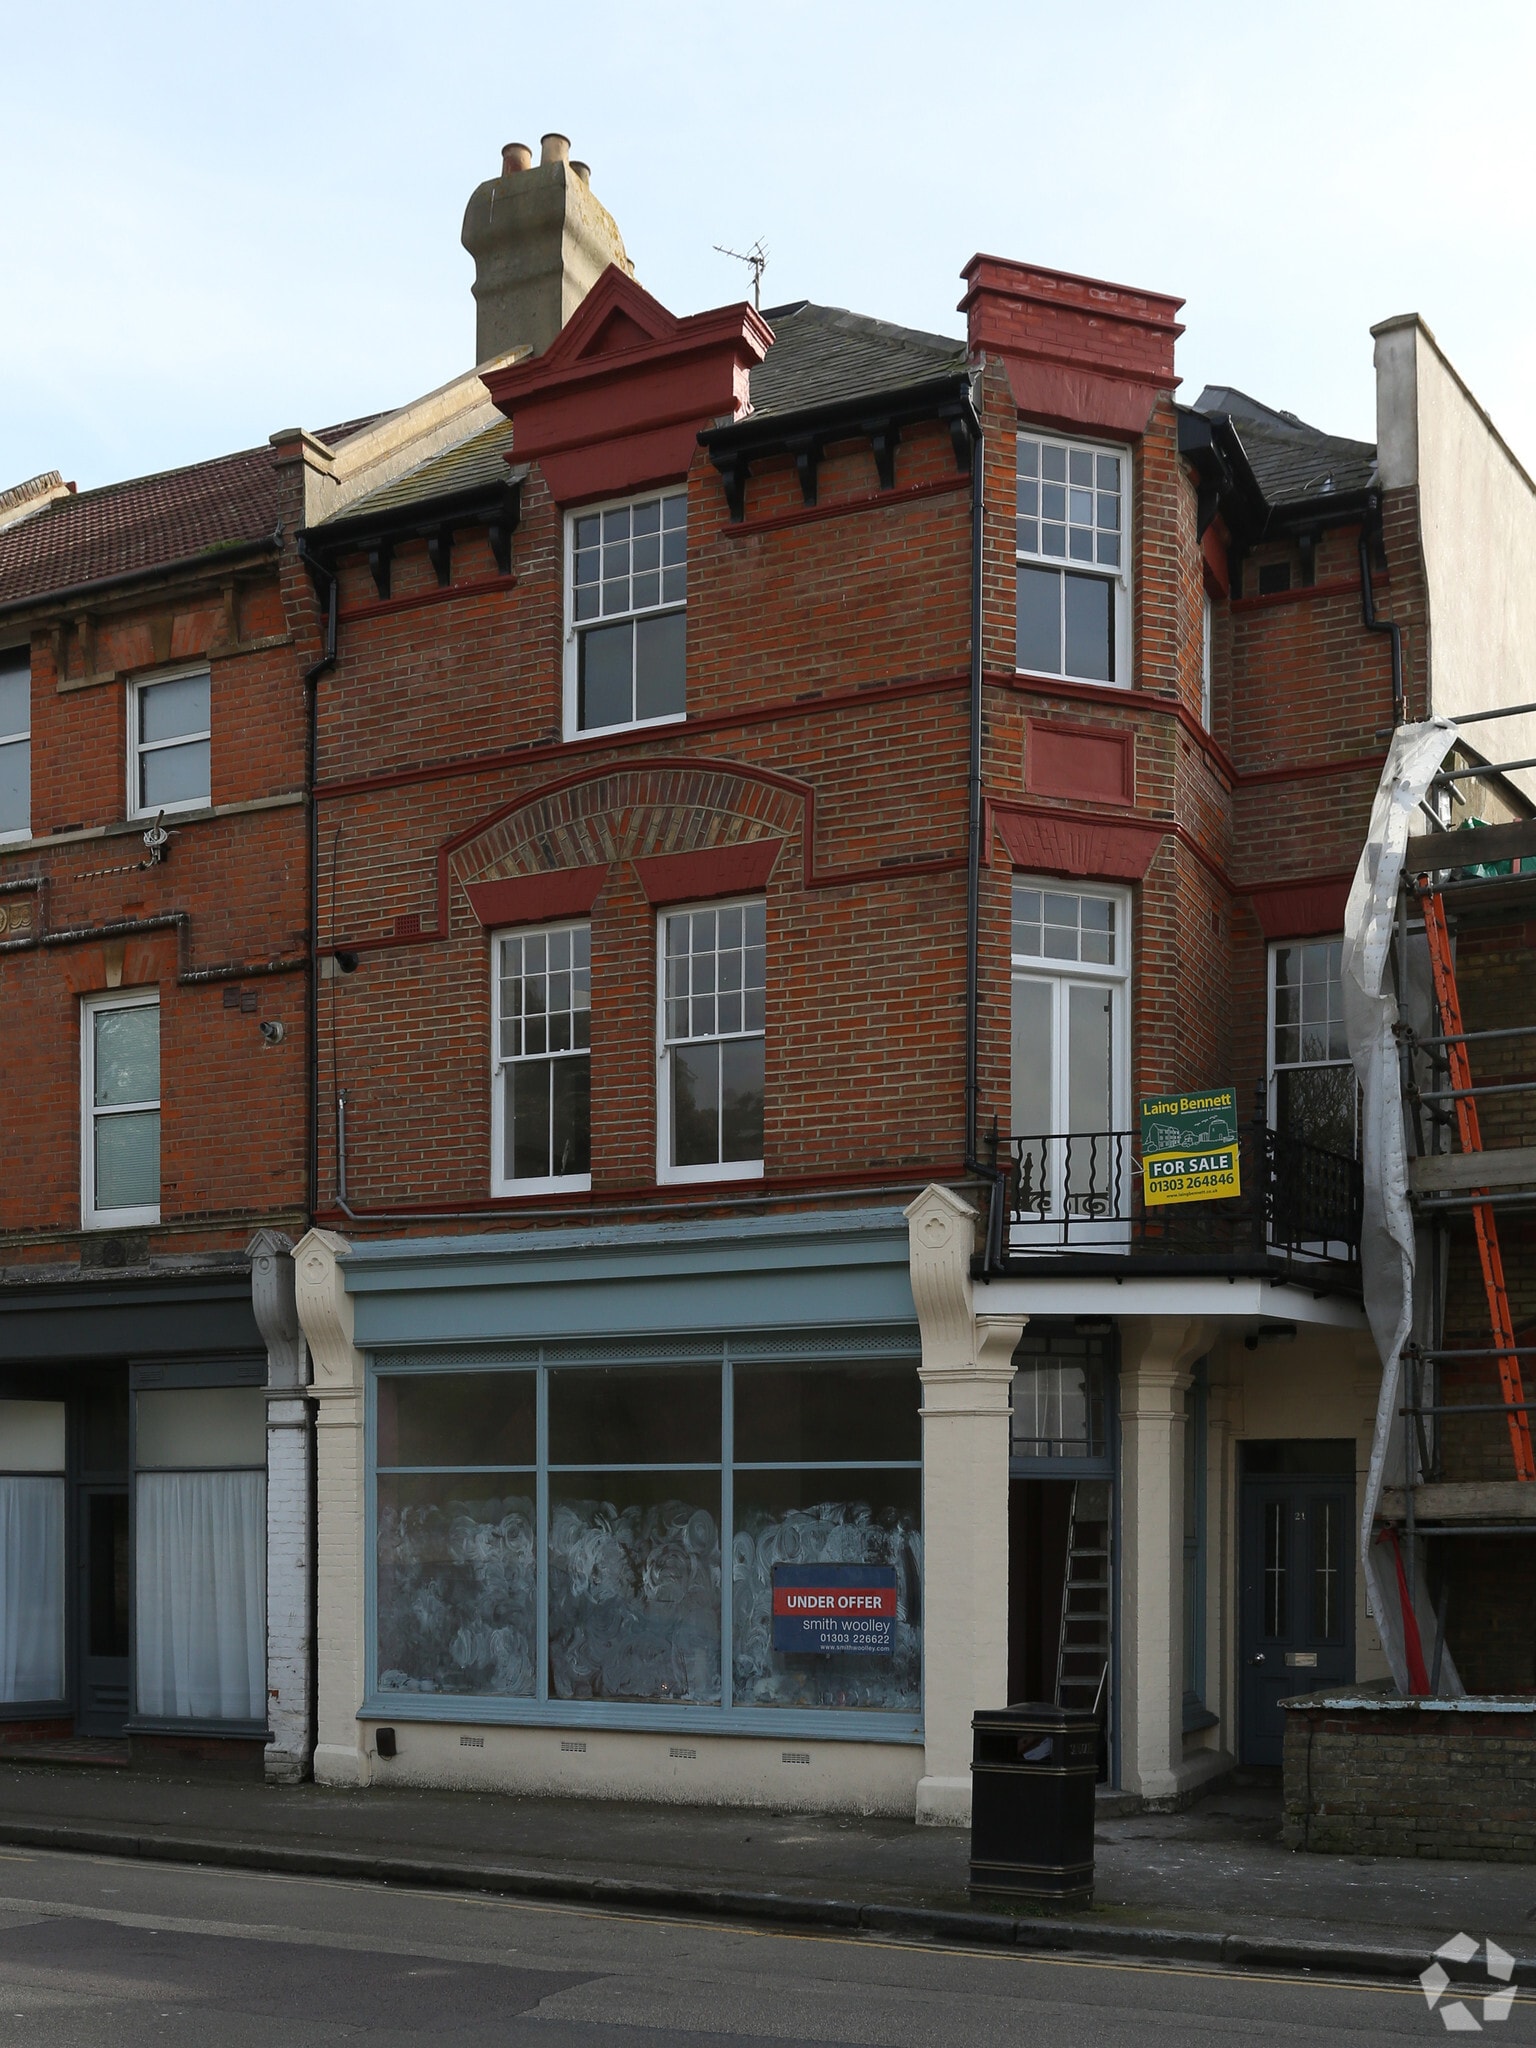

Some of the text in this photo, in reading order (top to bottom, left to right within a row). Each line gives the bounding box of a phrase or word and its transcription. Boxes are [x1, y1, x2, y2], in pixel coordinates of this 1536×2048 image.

[1143, 1101, 1178, 1116] Laing
[1180, 1093, 1232, 1111] Bennett
[1153, 1155, 1228, 1176] FOR SALE
[1149, 1173, 1234, 1193] 01303 264846
[1294, 1512, 1306, 1521] 21
[787, 1595, 882, 1609] UNDER OFFER
[802, 1618, 890, 1634] smith woolley
[820, 1633, 890, 1644] 01303 226622
[820, 1645, 890, 1653] www.smithwoolley.com
